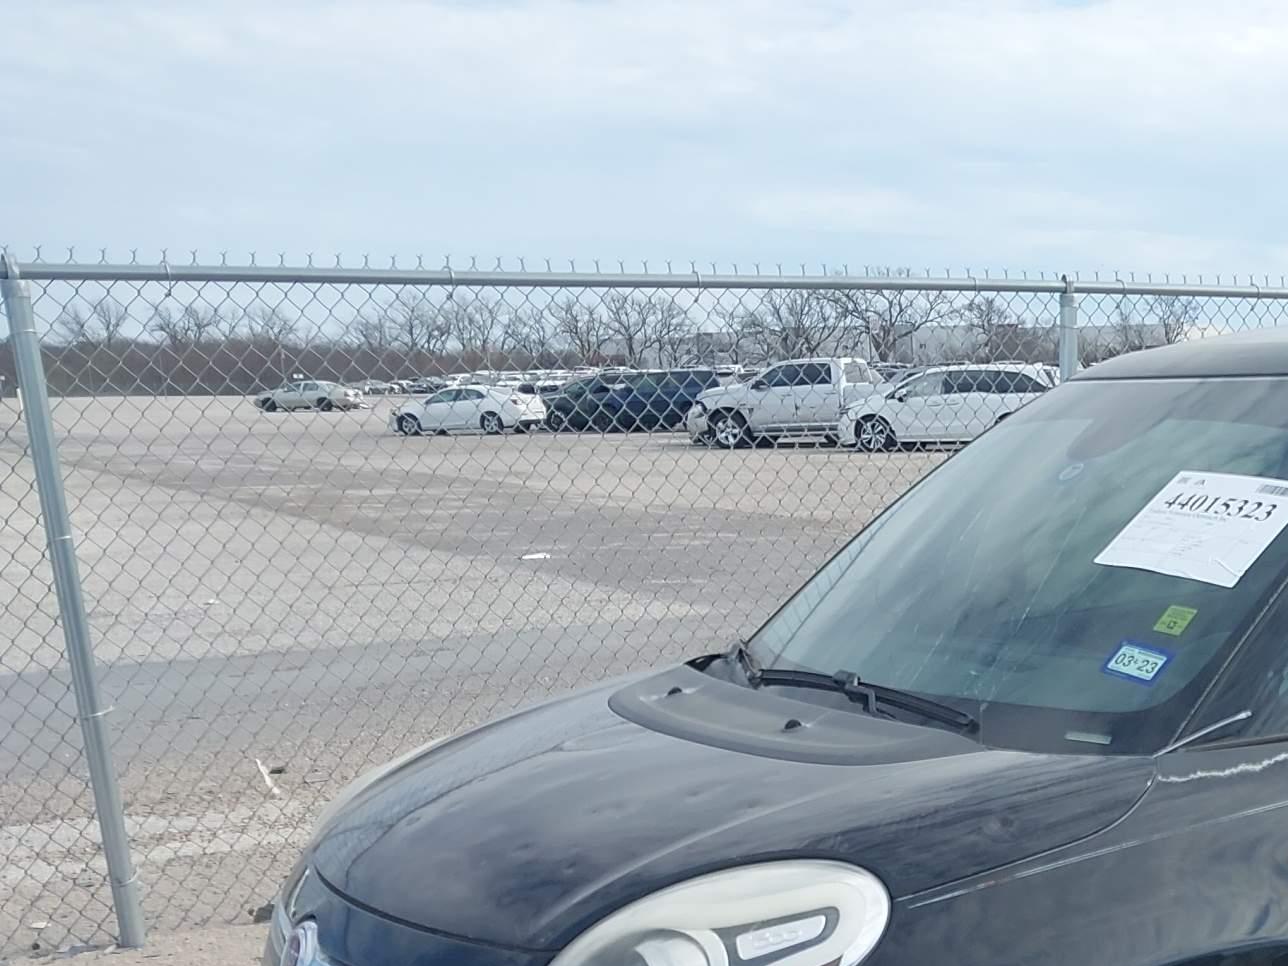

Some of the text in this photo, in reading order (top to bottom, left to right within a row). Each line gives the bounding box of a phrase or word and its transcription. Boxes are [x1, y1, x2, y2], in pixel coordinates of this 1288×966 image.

[1164, 491, 1277, 522] 44015323
[1114, 653, 1159, 674] 03 23
